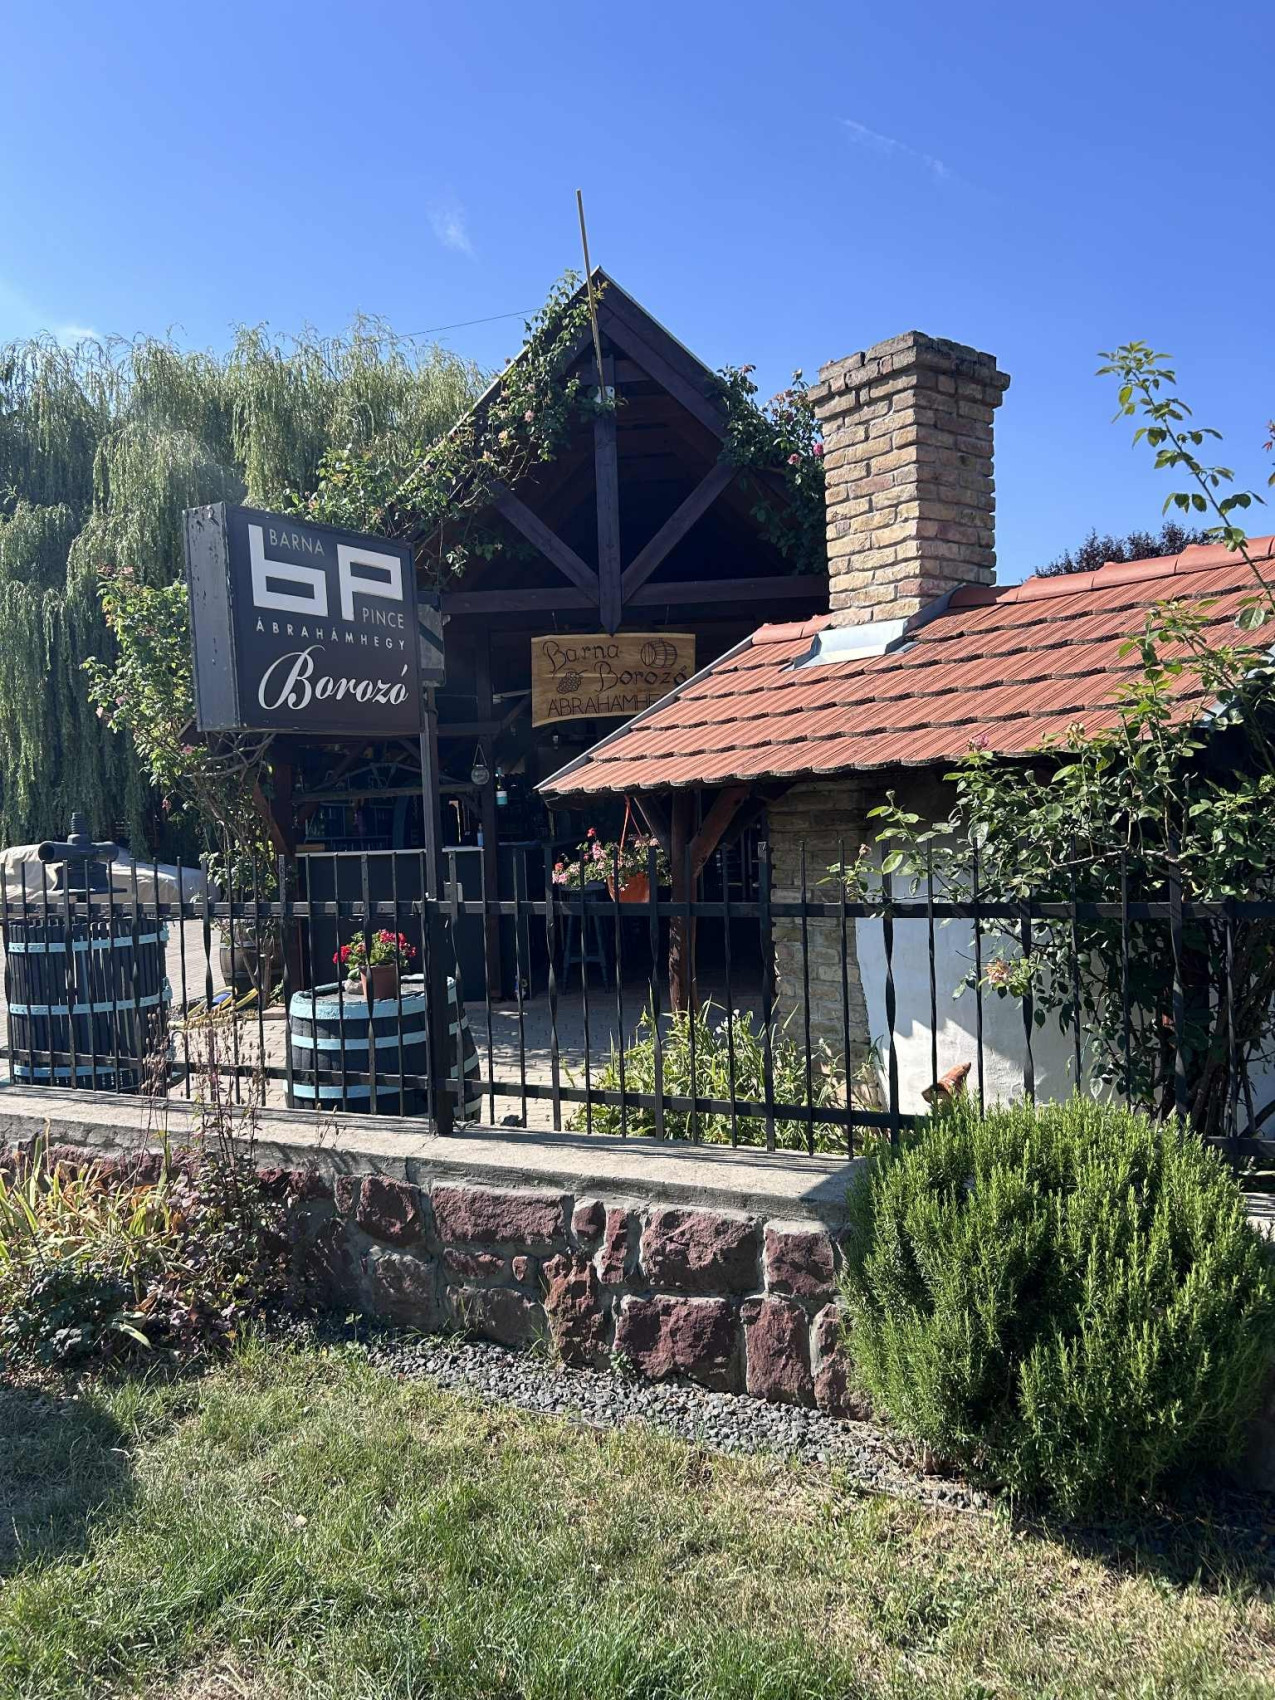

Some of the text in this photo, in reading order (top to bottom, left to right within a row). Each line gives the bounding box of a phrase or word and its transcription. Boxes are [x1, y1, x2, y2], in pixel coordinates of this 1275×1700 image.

[269, 528, 325, 556] BARNA
[256, 616, 405, 650] ÁBRAHÁMHEGY
[362, 607, 404, 629] PINCE
[542, 640, 620, 677] Barna
[258, 644, 409, 710] Borozó
[593, 660, 688, 693] Borozó
[548, 693, 664, 717] ÁBRAHÁMHE
